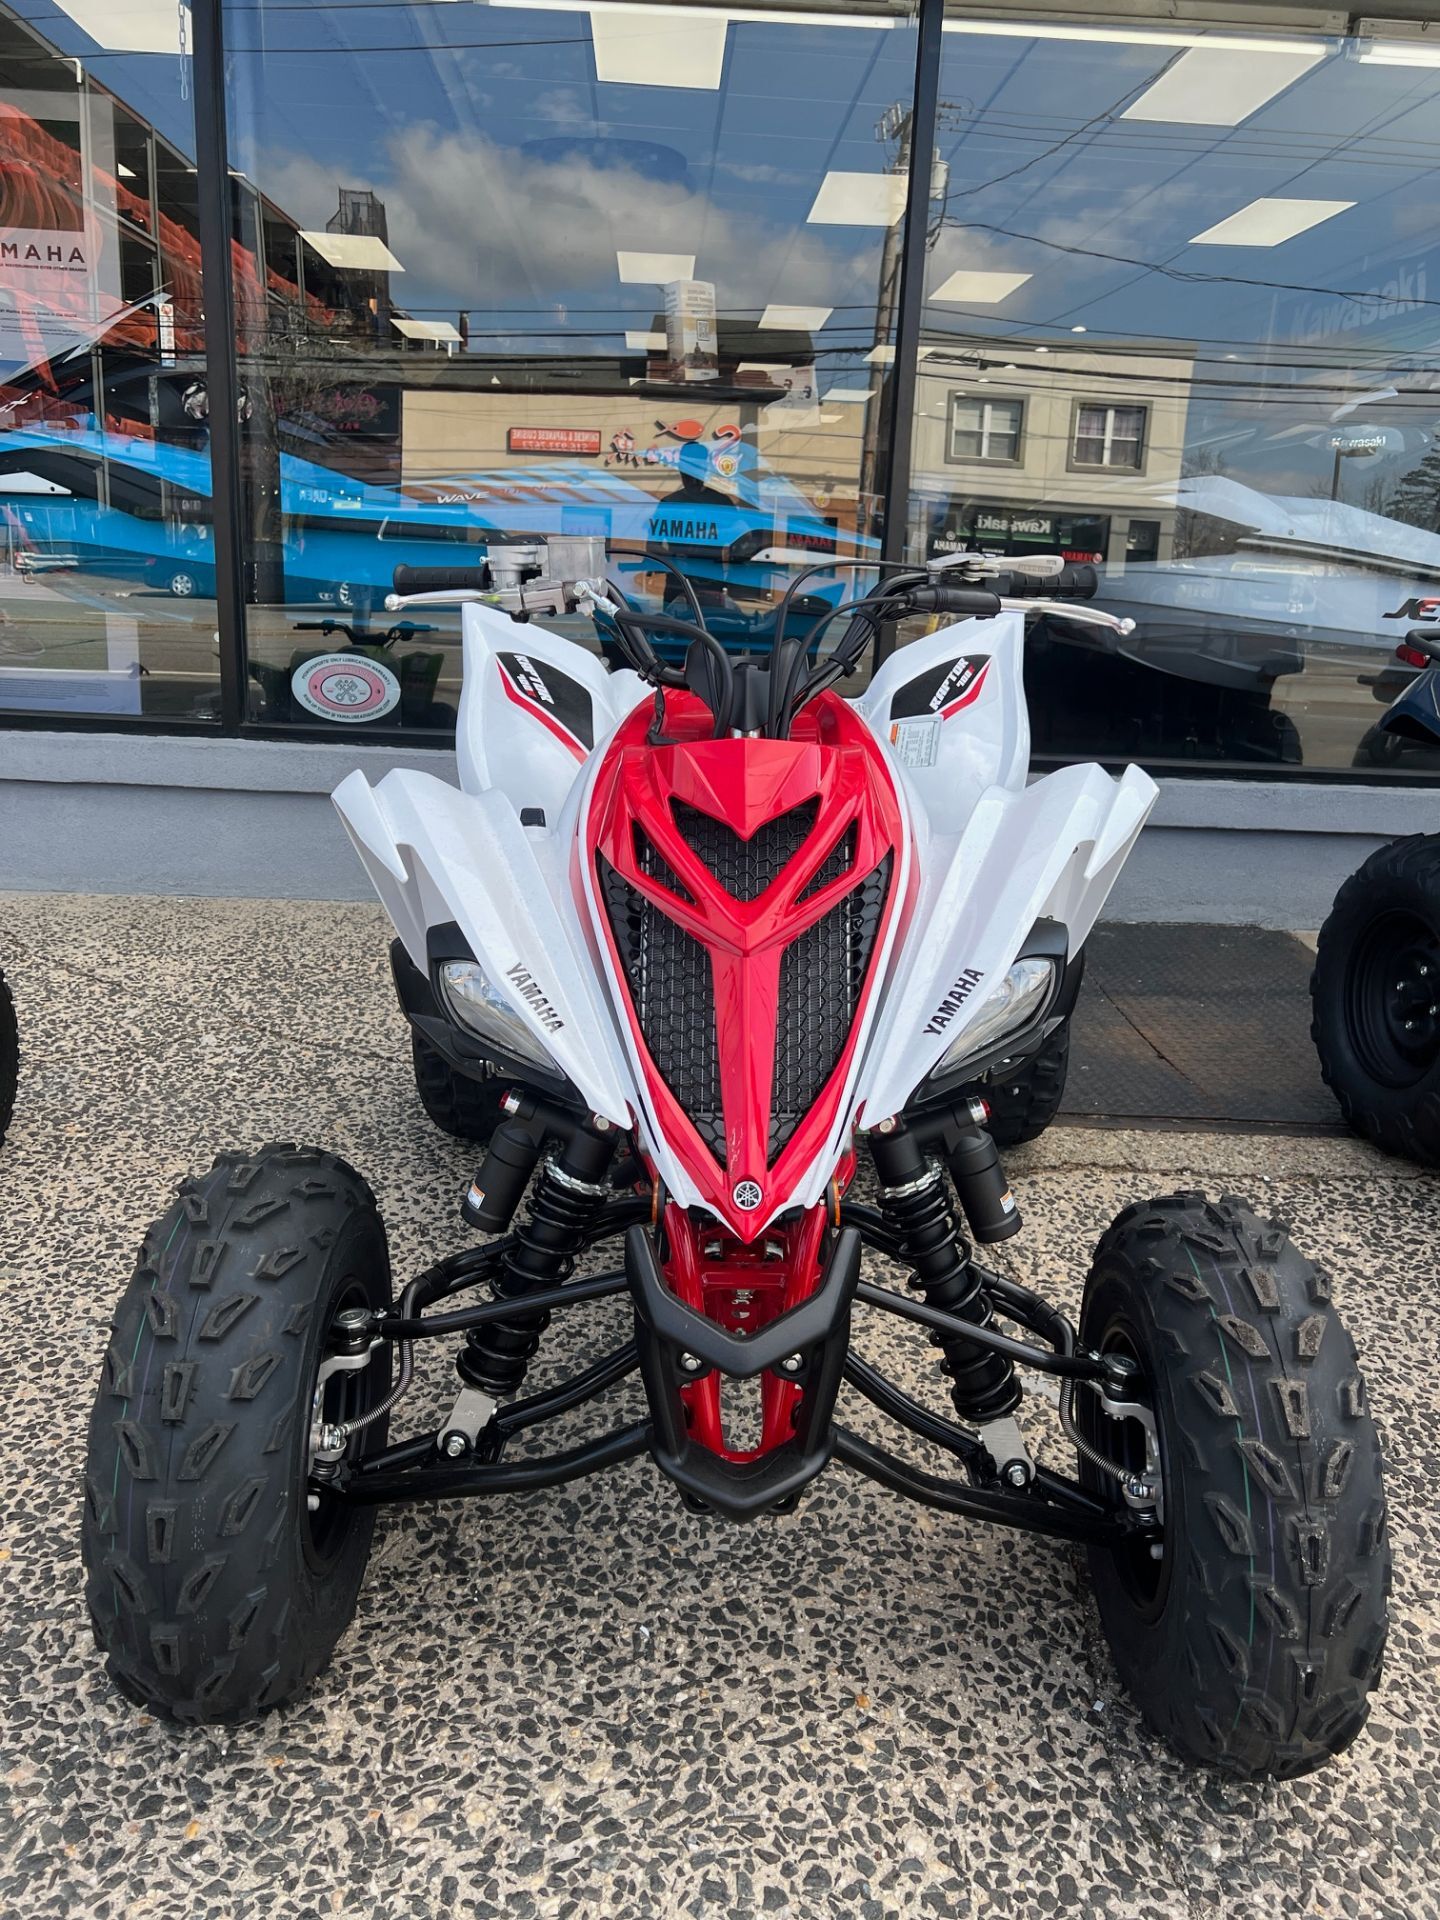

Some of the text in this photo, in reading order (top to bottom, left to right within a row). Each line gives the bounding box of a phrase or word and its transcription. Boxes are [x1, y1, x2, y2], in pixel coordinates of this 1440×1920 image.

[1291, 262, 1426, 346] Kawasaki
[1331, 435, 1387, 447] Kawasaki
[437, 491, 489, 504] WAVE
[649, 518, 718, 540] YAMAHA
[1382, 598, 1440, 622] JE
[513, 654, 555, 705] RAPTOR
[929, 657, 969, 711] RAPTOR
[506, 962, 565, 1033] YAMAHA
[922, 968, 985, 1036] YAMAHA
